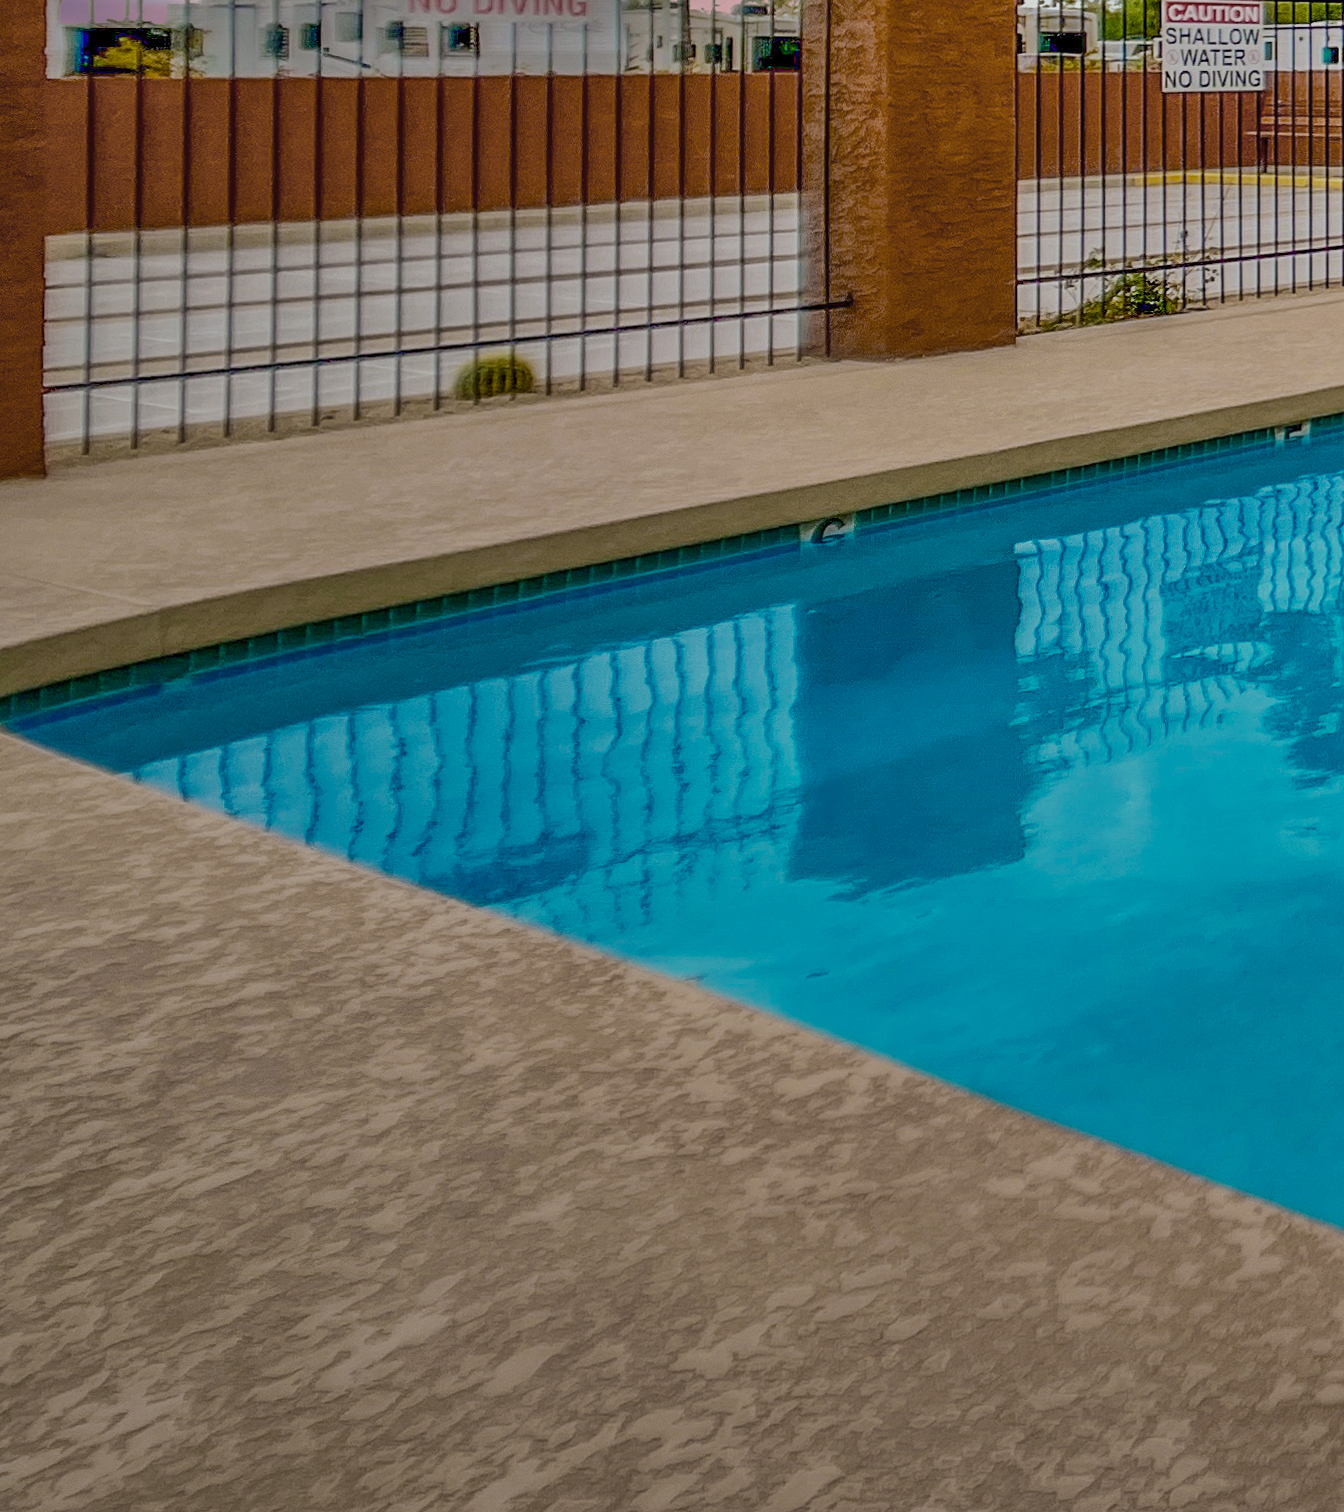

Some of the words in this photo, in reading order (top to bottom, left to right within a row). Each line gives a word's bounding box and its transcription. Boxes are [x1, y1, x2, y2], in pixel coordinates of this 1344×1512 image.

[1168, 4, 1259, 23] CAUTION
[1166, 27, 1260, 45] SHALLOW
[1180, 49, 1246, 66] WATER
[1165, 70, 1192, 88] NO
[1199, 70, 1260, 88] DIVING
